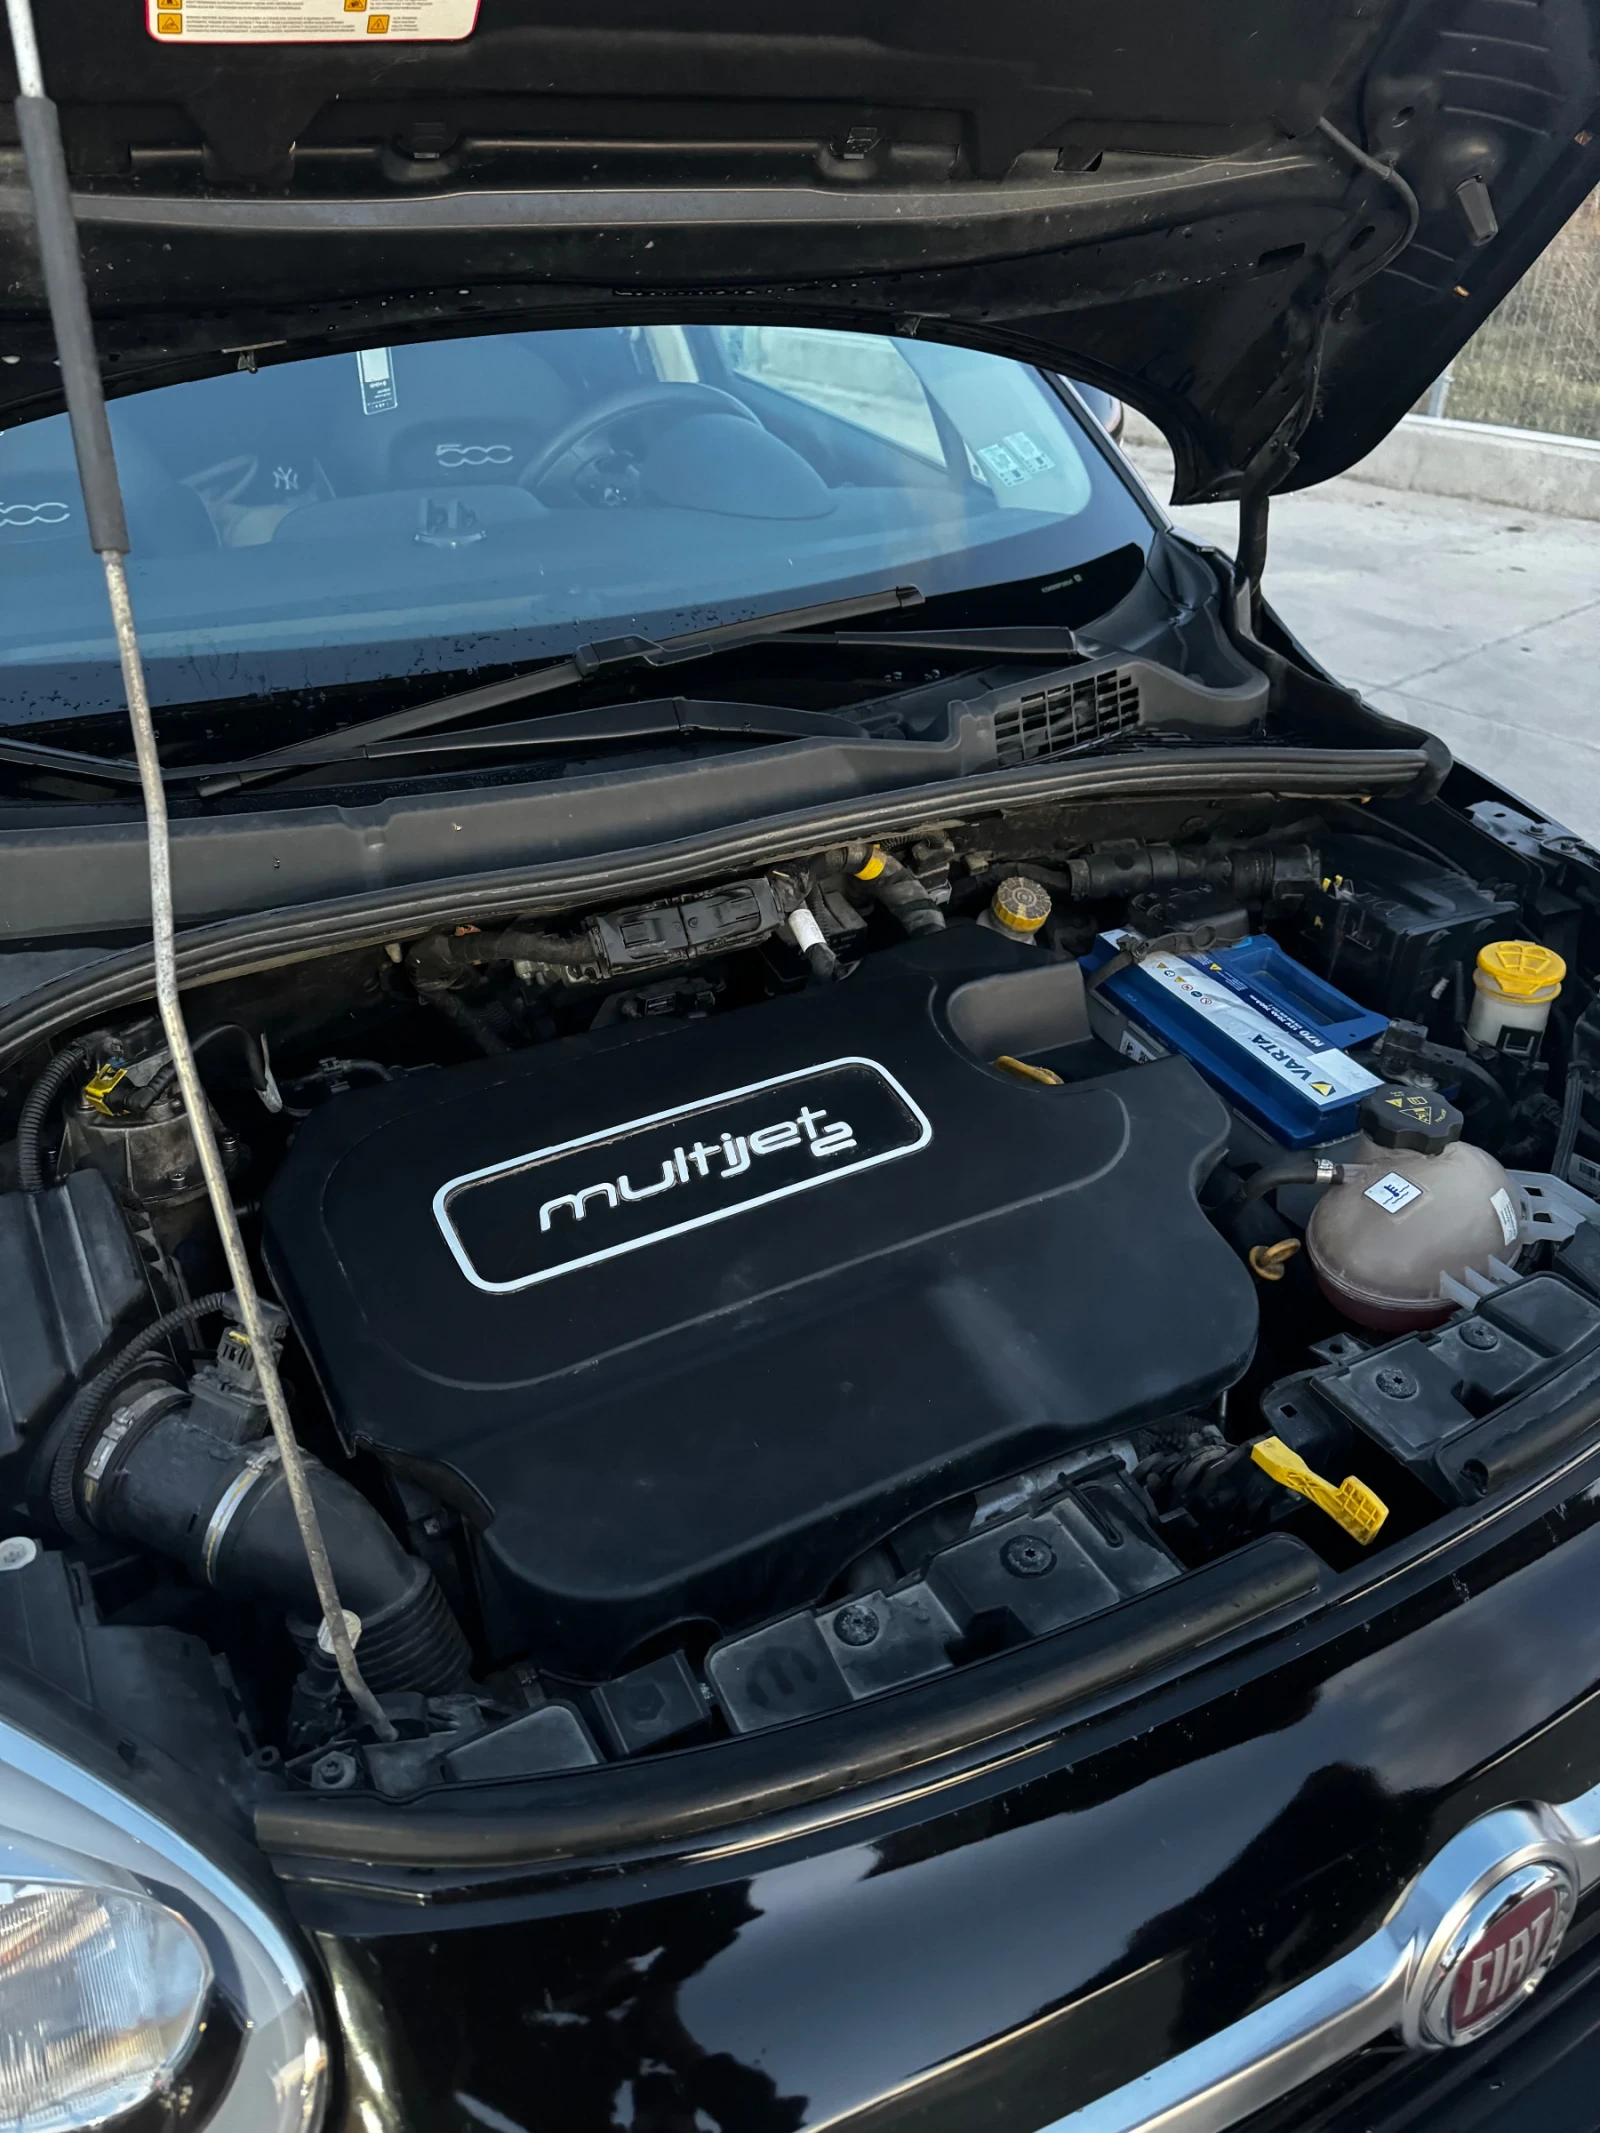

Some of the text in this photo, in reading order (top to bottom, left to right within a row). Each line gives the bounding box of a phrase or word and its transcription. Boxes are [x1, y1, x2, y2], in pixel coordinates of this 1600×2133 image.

[435, 444, 513, 467] 500
[0, 502, 70, 527] 00
[1299, 1030, 1325, 1047] N70
[1251, 1034, 1312, 1081] VARTA
[1463, 1907, 1551, 2017] FIAT
